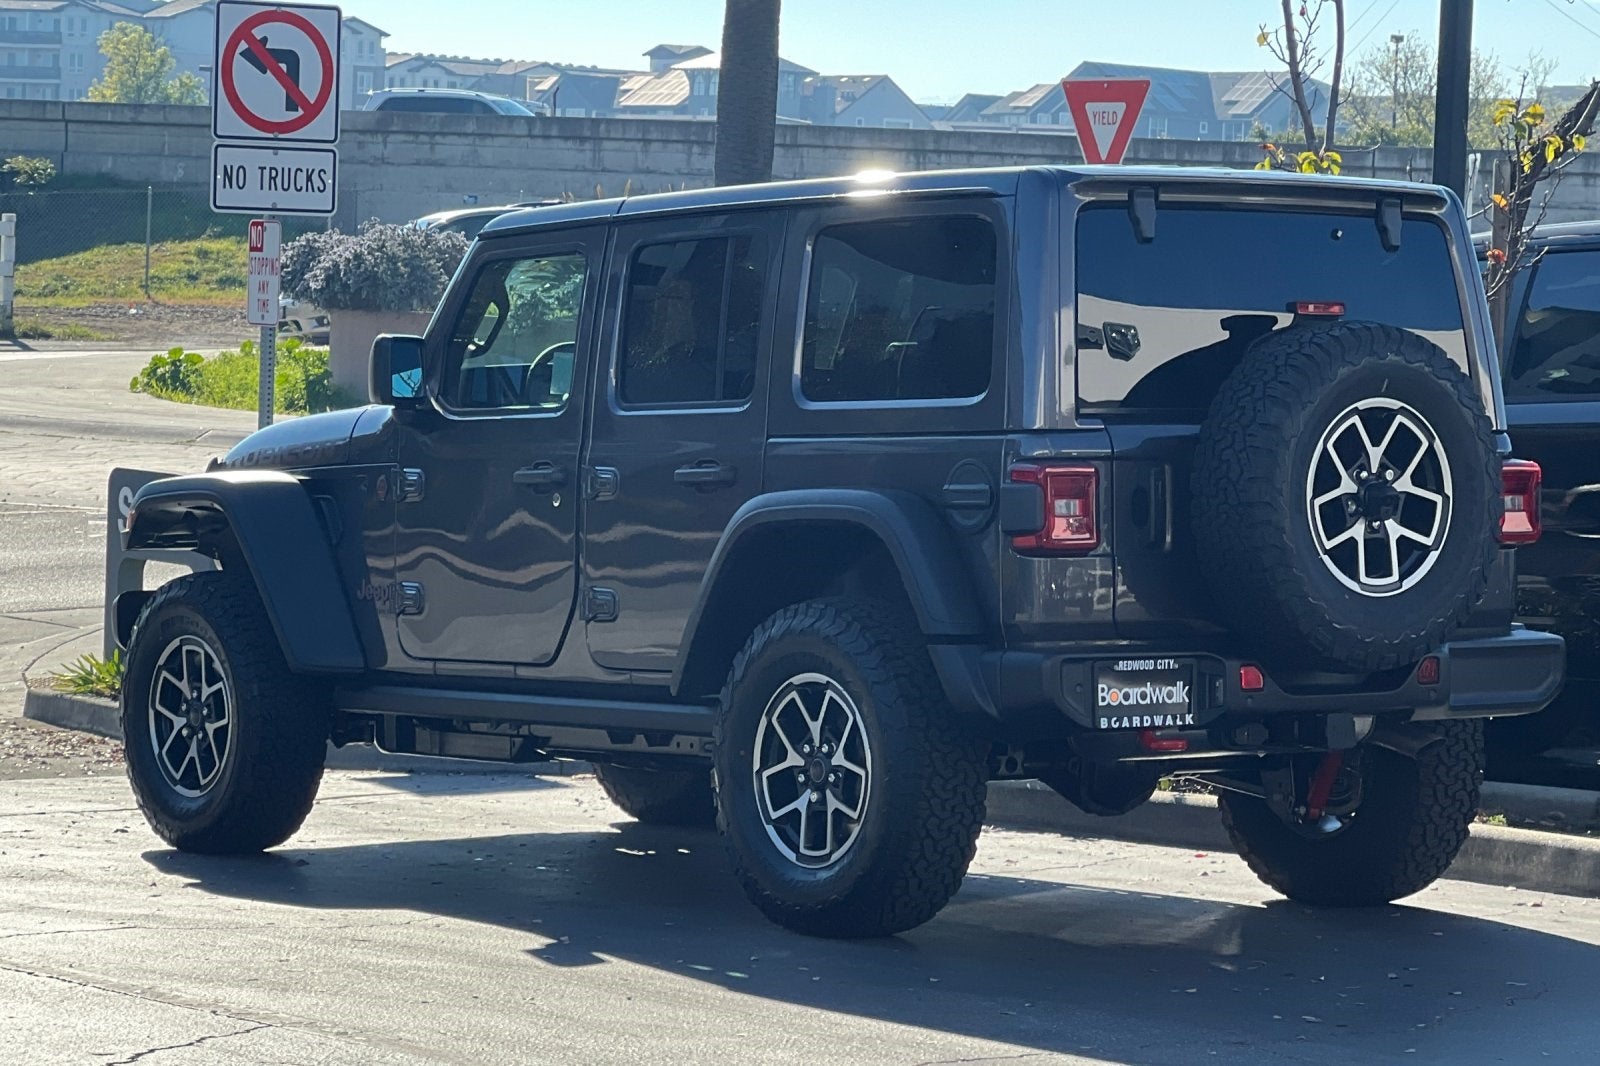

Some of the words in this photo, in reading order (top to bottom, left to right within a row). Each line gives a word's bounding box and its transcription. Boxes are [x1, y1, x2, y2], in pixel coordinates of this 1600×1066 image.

[1093, 111, 1118, 125] YIELD
[223, 165, 247, 190] NO
[258, 166, 327, 193] TRUCKS
[251, 225, 263, 248] NO
[249, 257, 279, 275] STOPPING
[257, 280, 270, 294] ANY
[257, 299, 270, 313] TIME
[357, 579, 390, 605] Jeep
[1118, 660, 1155, 671] REDWOOD
[1157, 659, 1175, 670] CITY
[1098, 681, 1190, 706] Boardwalk
[1100, 714, 1194, 729] BOARDWALK
